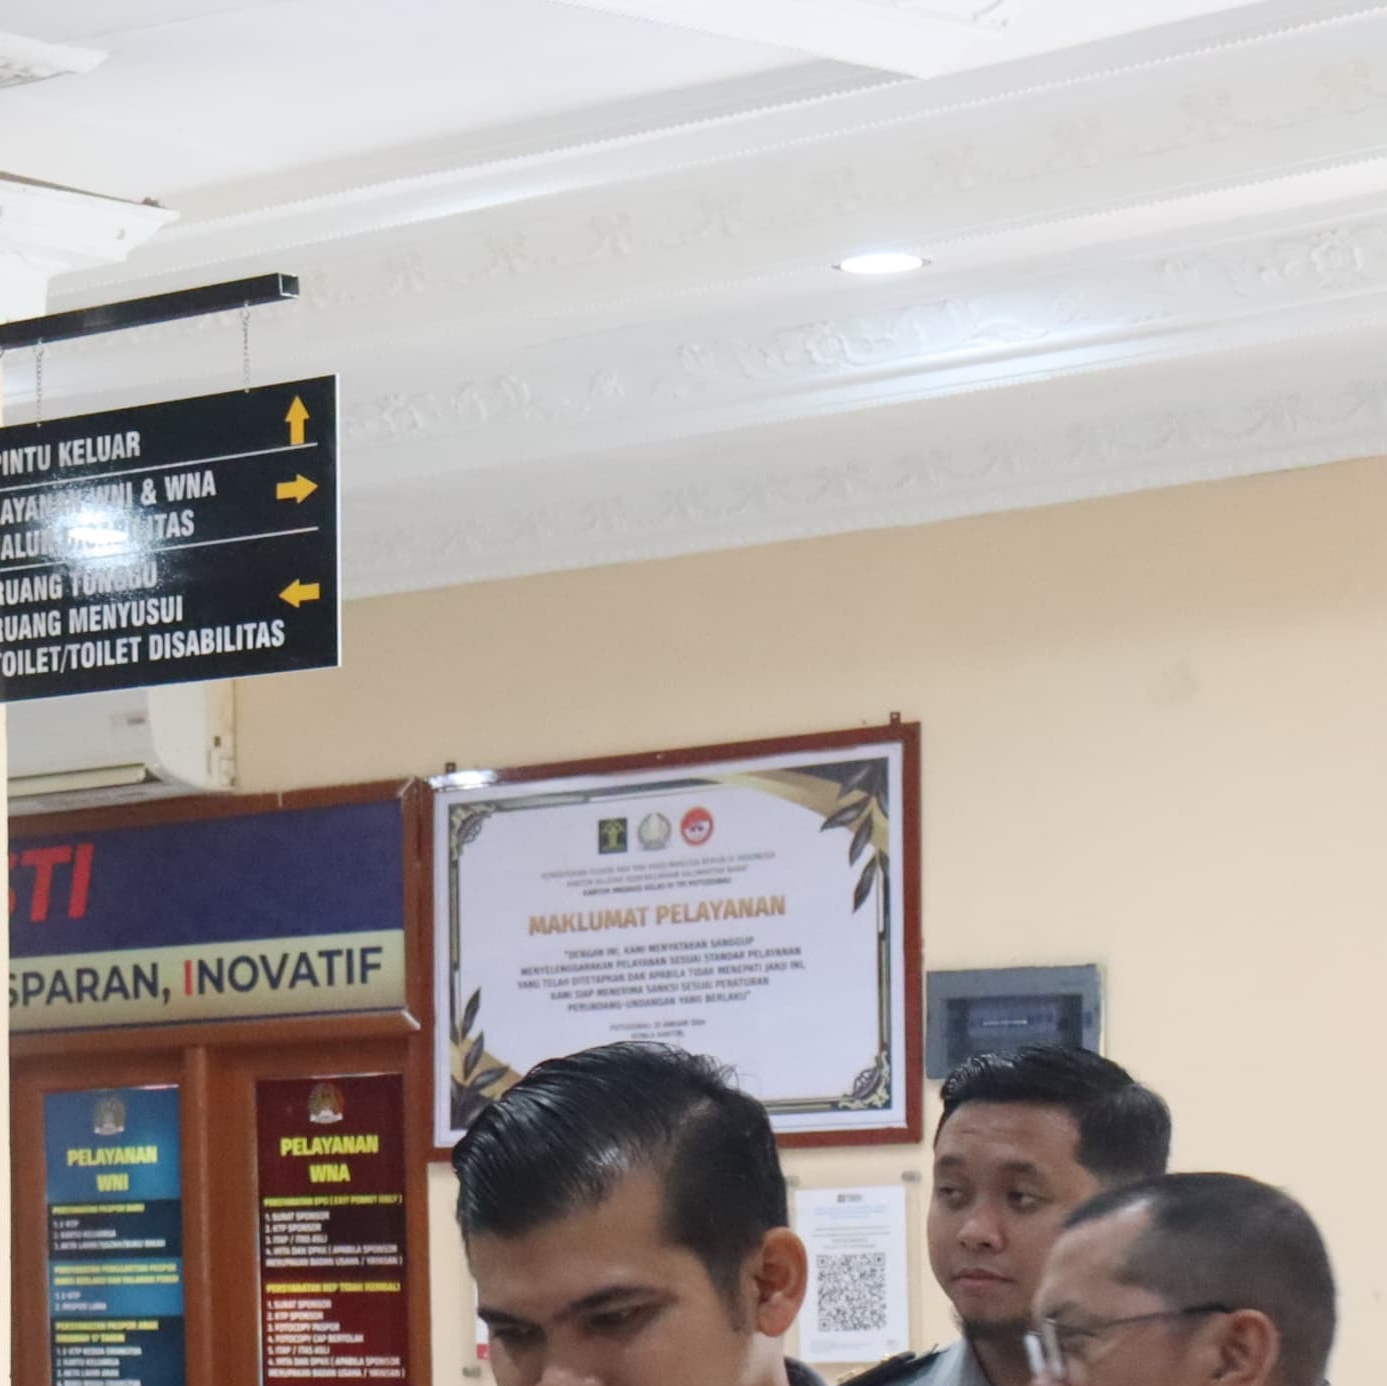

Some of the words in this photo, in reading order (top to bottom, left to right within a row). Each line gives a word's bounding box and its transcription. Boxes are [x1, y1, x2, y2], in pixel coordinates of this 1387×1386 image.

[59, 431, 140, 468] KELUAR
[141, 478, 157, 506] &
[165, 471, 216, 499] WNA
[71, 561, 158, 597] TUNGGU
[68, 596, 184, 635] MENYUSUI
[148, 620, 285, 662] DISABILITAS
[530, 906, 649, 936] MAKLUMAT
[656, 895, 785, 926] PELAYANAN
[184, 946, 383, 996] INOVATIF
[67, 1146, 158, 1166] PELAYANAN
[280, 1136, 379, 1156] PELAYANAN
[97, 1174, 128, 1192] WNI
[310, 1164, 350, 1183] WNA
